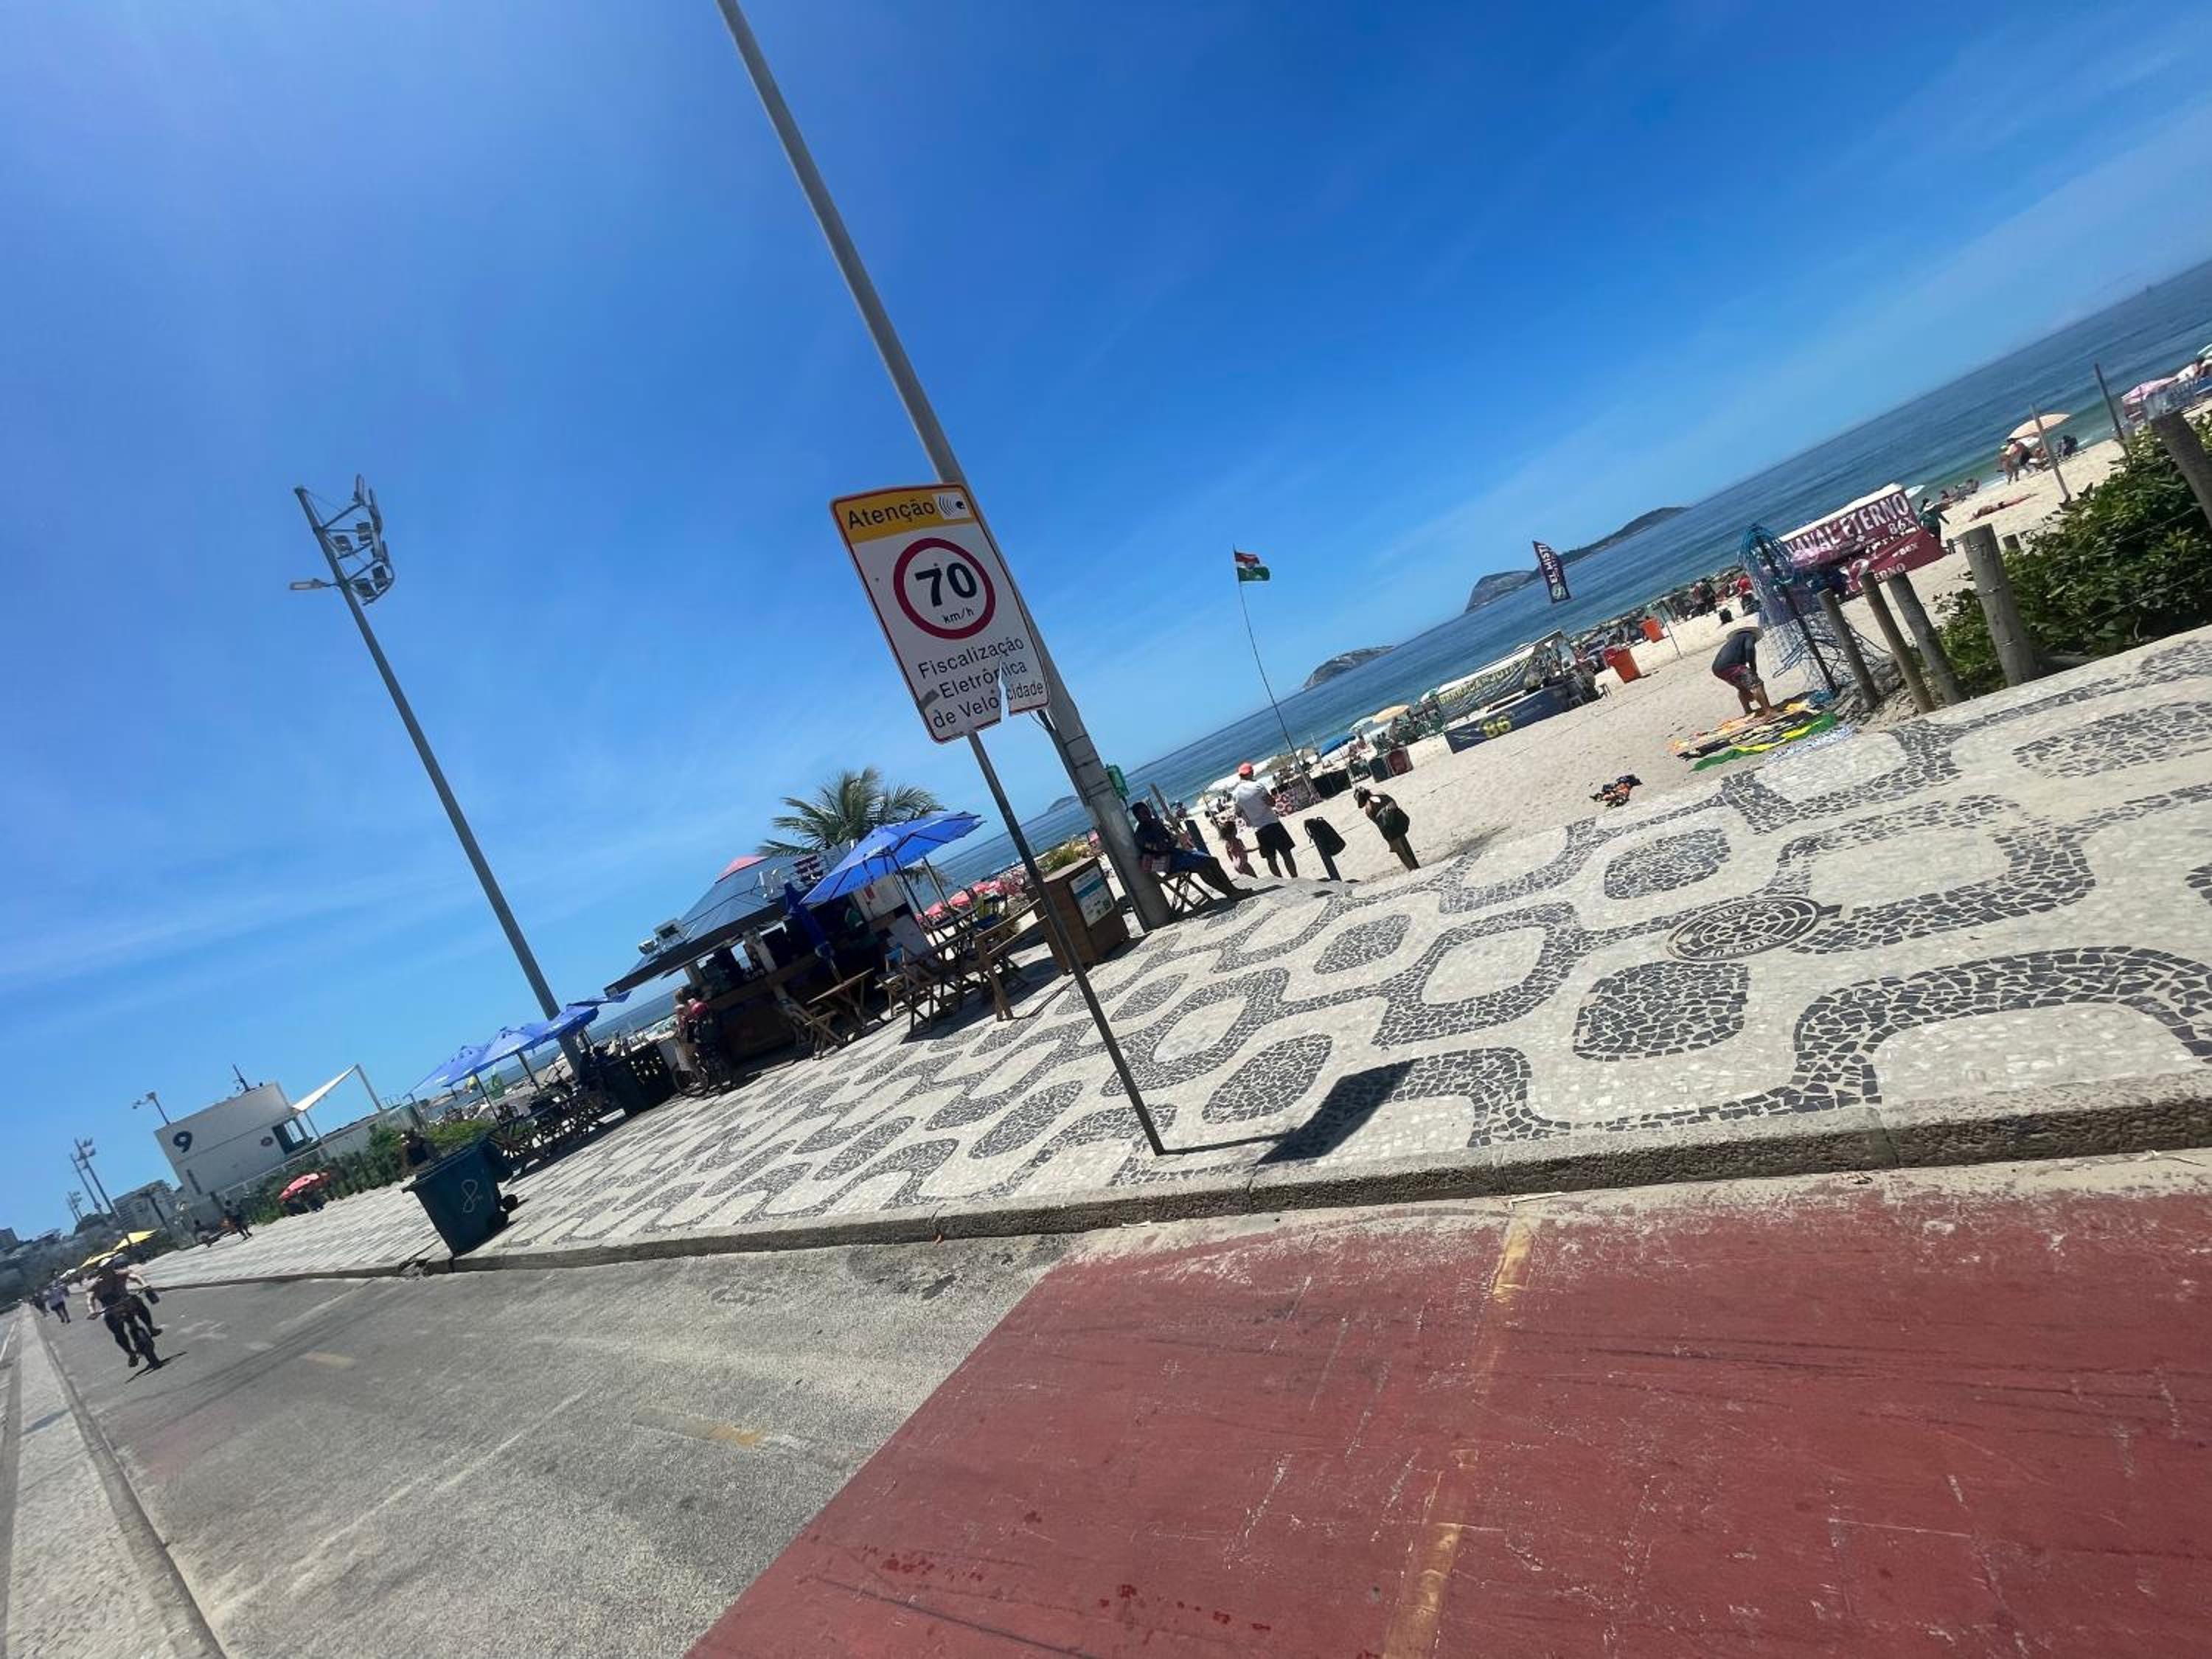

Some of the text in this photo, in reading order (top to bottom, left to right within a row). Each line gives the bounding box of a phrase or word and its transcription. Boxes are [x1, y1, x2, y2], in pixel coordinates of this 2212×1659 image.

[849, 499, 935, 529] Atenção
[1840, 493, 1909, 538] ETERNO
[914, 563, 977, 607] 70
[943, 608, 974, 624] km/h
[918, 637, 1024, 678] Fiscalização
[939, 661, 1027, 698] Eletrônica
[933, 709, 956, 728] de
[173, 1131, 193, 1153] 9
